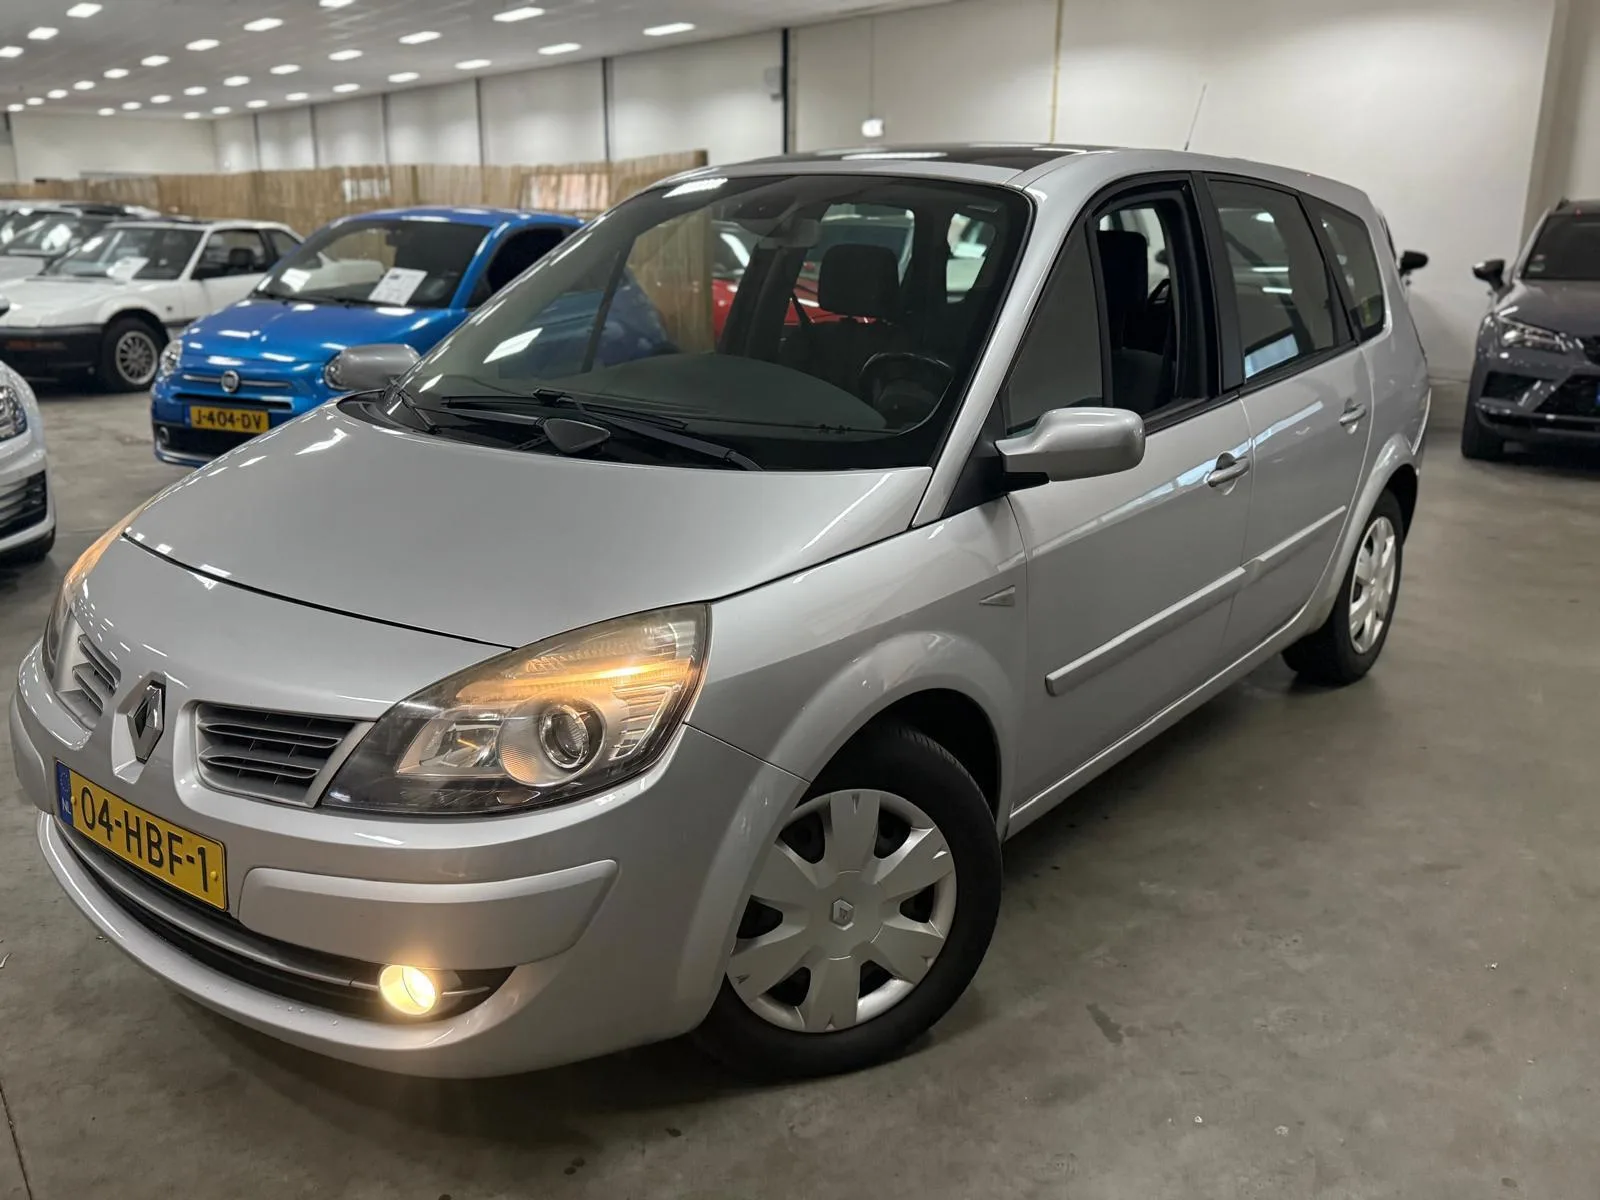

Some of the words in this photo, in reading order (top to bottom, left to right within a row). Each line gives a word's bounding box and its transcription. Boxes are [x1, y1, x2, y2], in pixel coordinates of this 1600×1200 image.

[194, 409, 262, 430] J-404-DV
[61, 796, 72, 815] NL
[81, 786, 208, 893] 04-HBF-1
